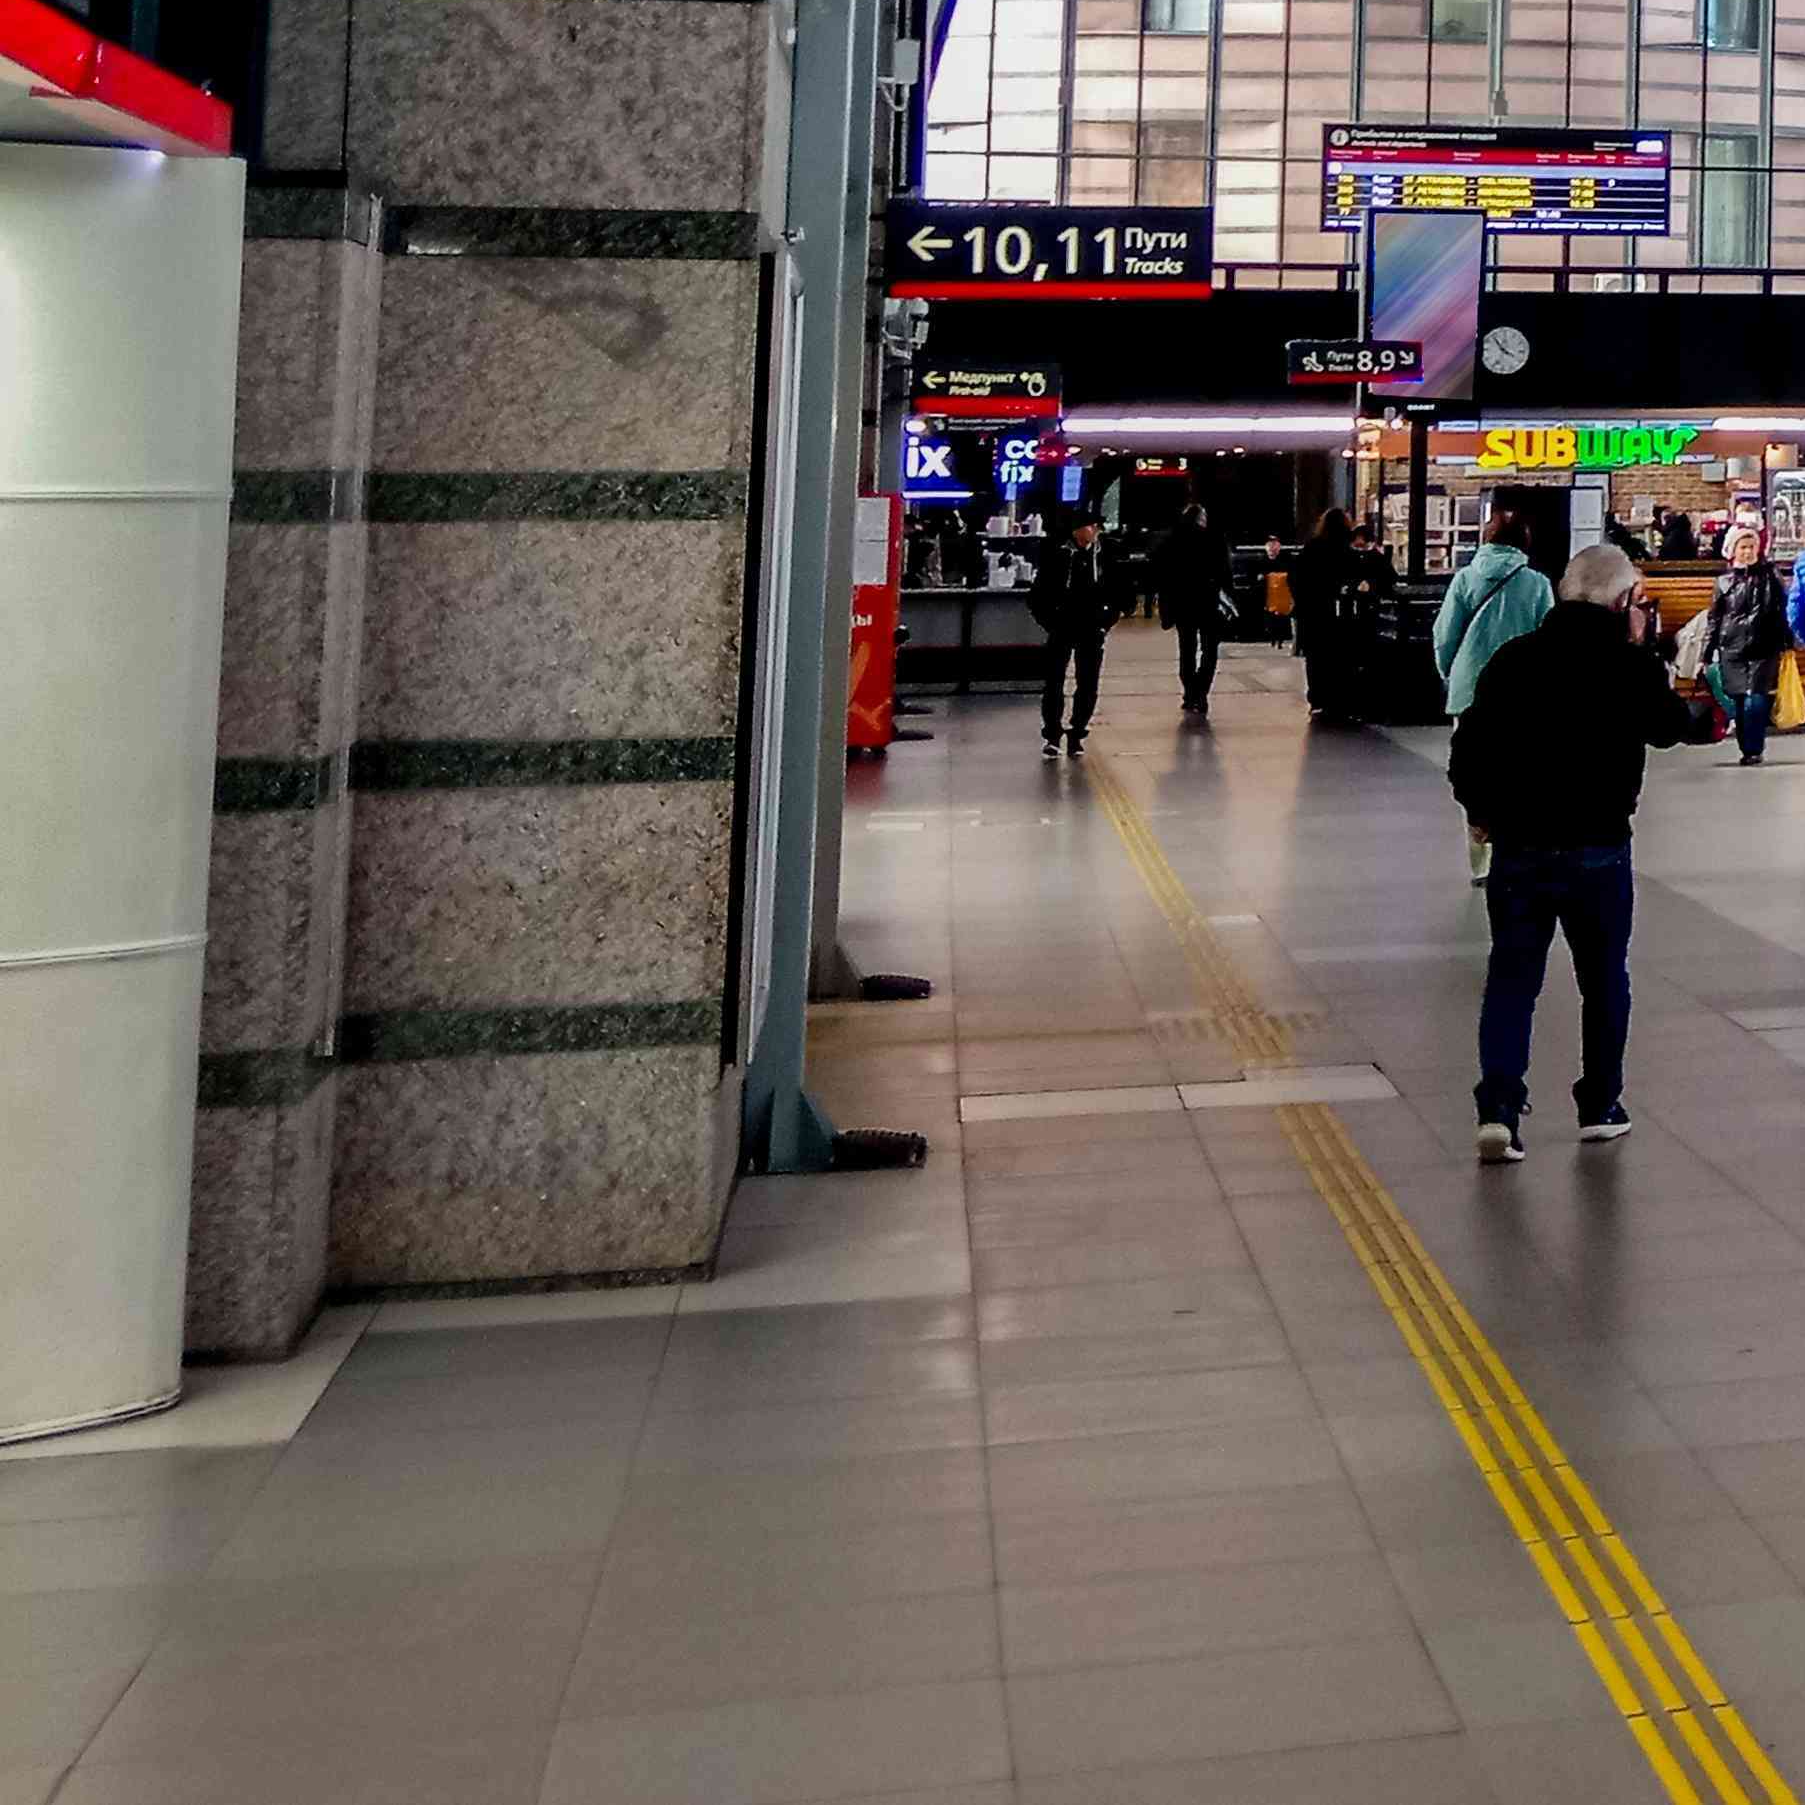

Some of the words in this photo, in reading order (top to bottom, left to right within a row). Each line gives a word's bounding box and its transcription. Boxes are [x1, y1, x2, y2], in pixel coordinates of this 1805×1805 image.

[963, 226, 1116, 282] 10,11
[1124, 227, 1188, 255] Пути
[1124, 257, 1185, 275] Tracks
[1357, 350, 1396, 375] 8,9
[949, 370, 1017, 385] Медпункт
[1477, 427, 1699, 469] SUBWAY
